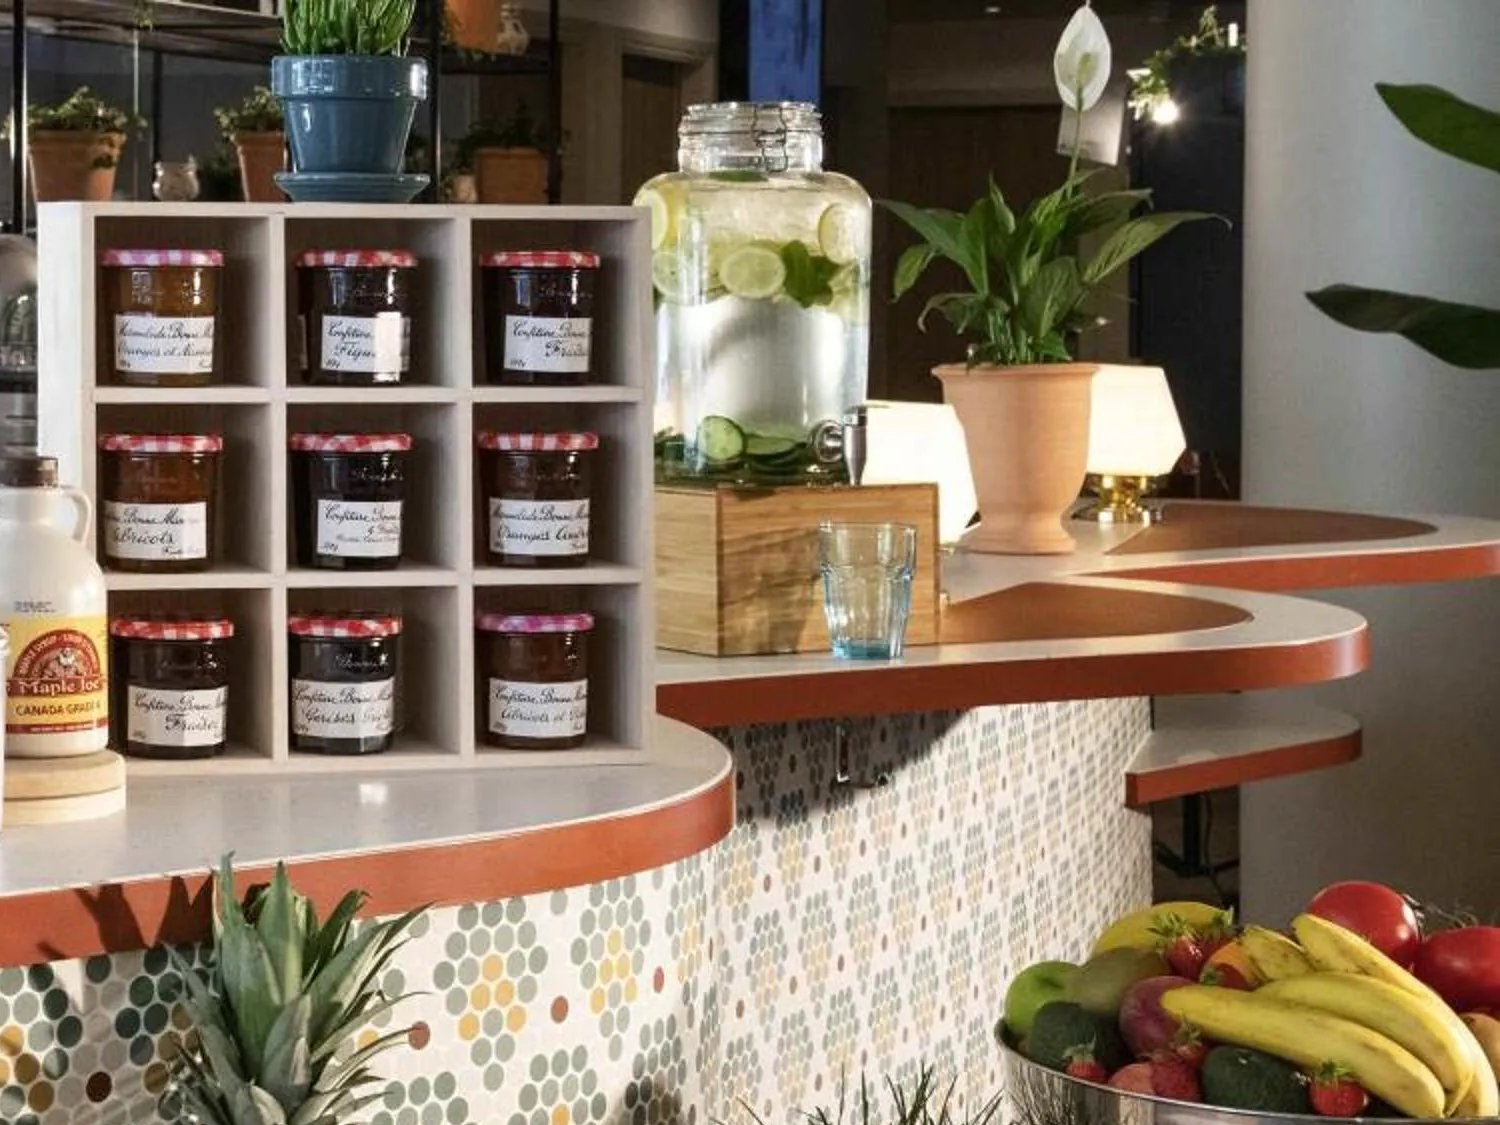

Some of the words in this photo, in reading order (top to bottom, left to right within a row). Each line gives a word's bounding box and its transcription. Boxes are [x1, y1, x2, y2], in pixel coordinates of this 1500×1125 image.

[18, 678, 78, 697] Maple
[79, 676, 101, 693] Joe
[15, 702, 64, 716] CANADA
